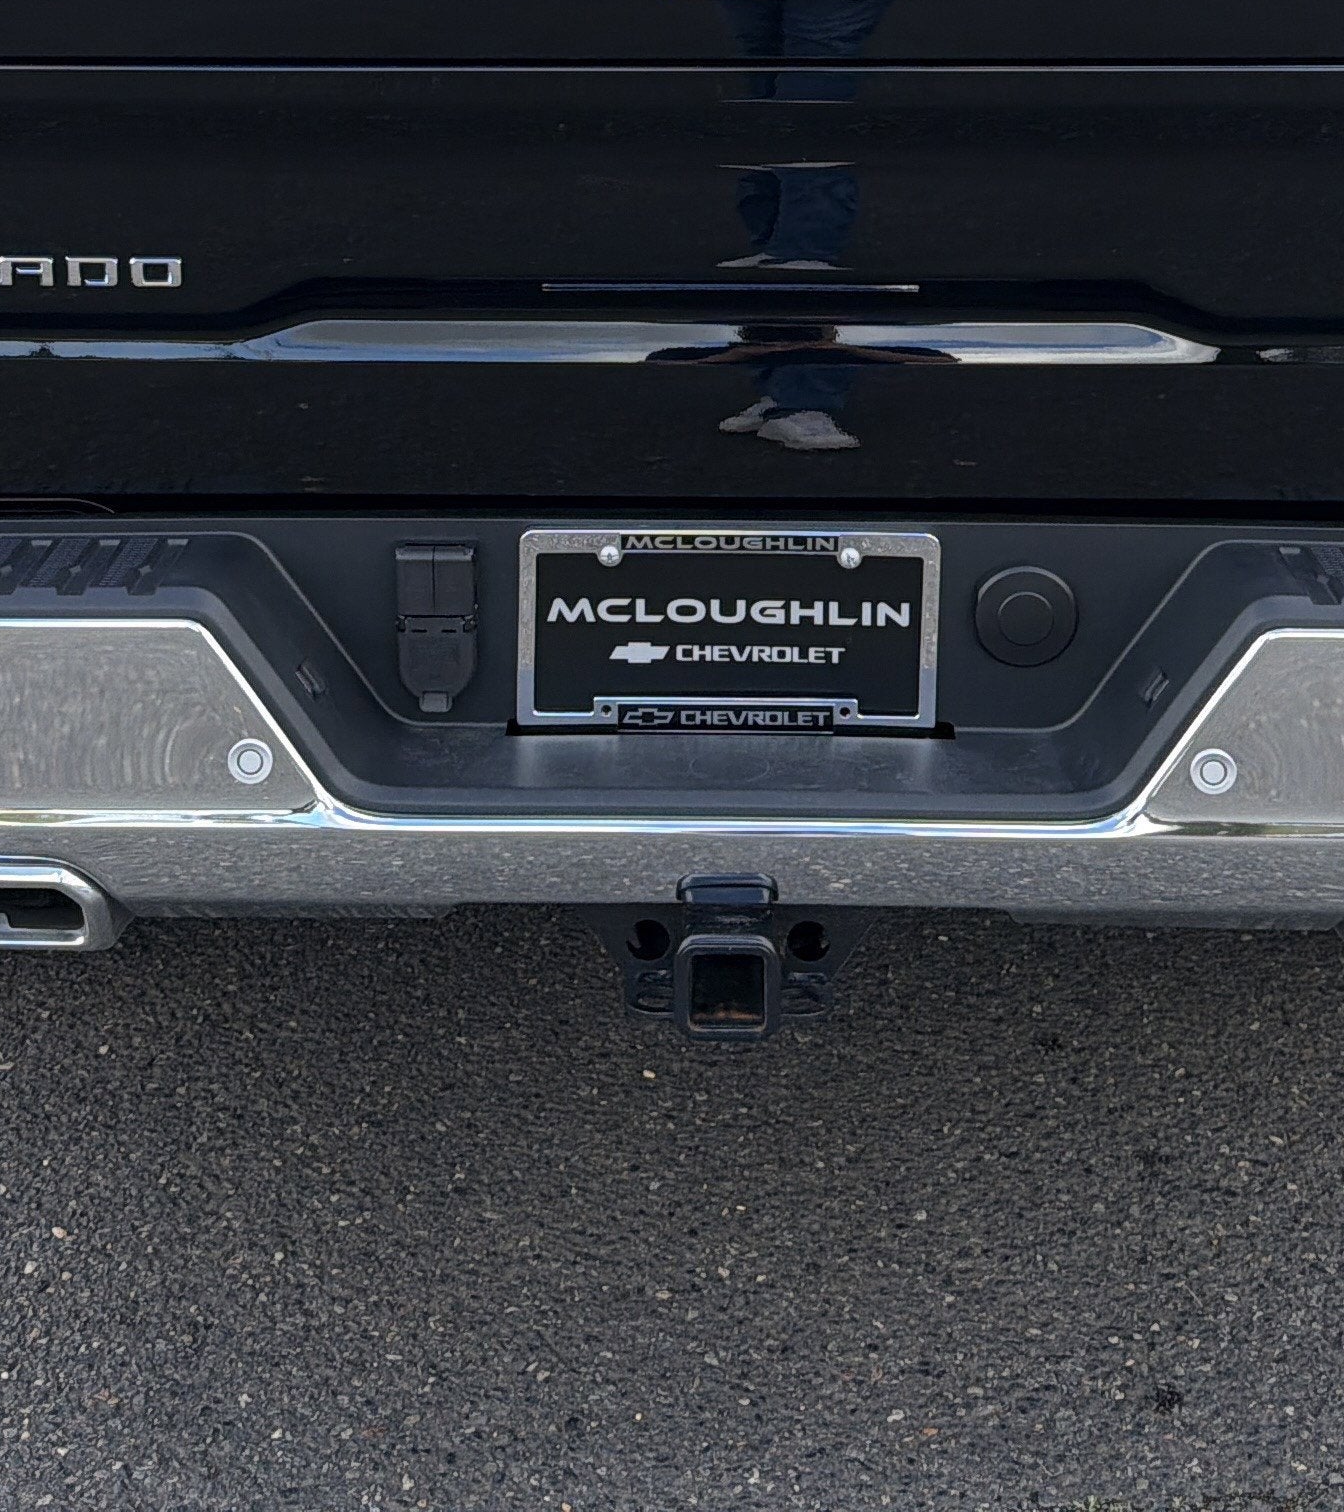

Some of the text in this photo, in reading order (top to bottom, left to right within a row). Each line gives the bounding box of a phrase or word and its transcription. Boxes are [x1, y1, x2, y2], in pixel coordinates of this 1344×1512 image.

[624, 535, 837, 551] MCLOUGHLIN
[546, 597, 911, 628] MCLOUGHLIN
[675, 644, 846, 664] CHEVROLET
[680, 709, 831, 727] CHEVROLET
